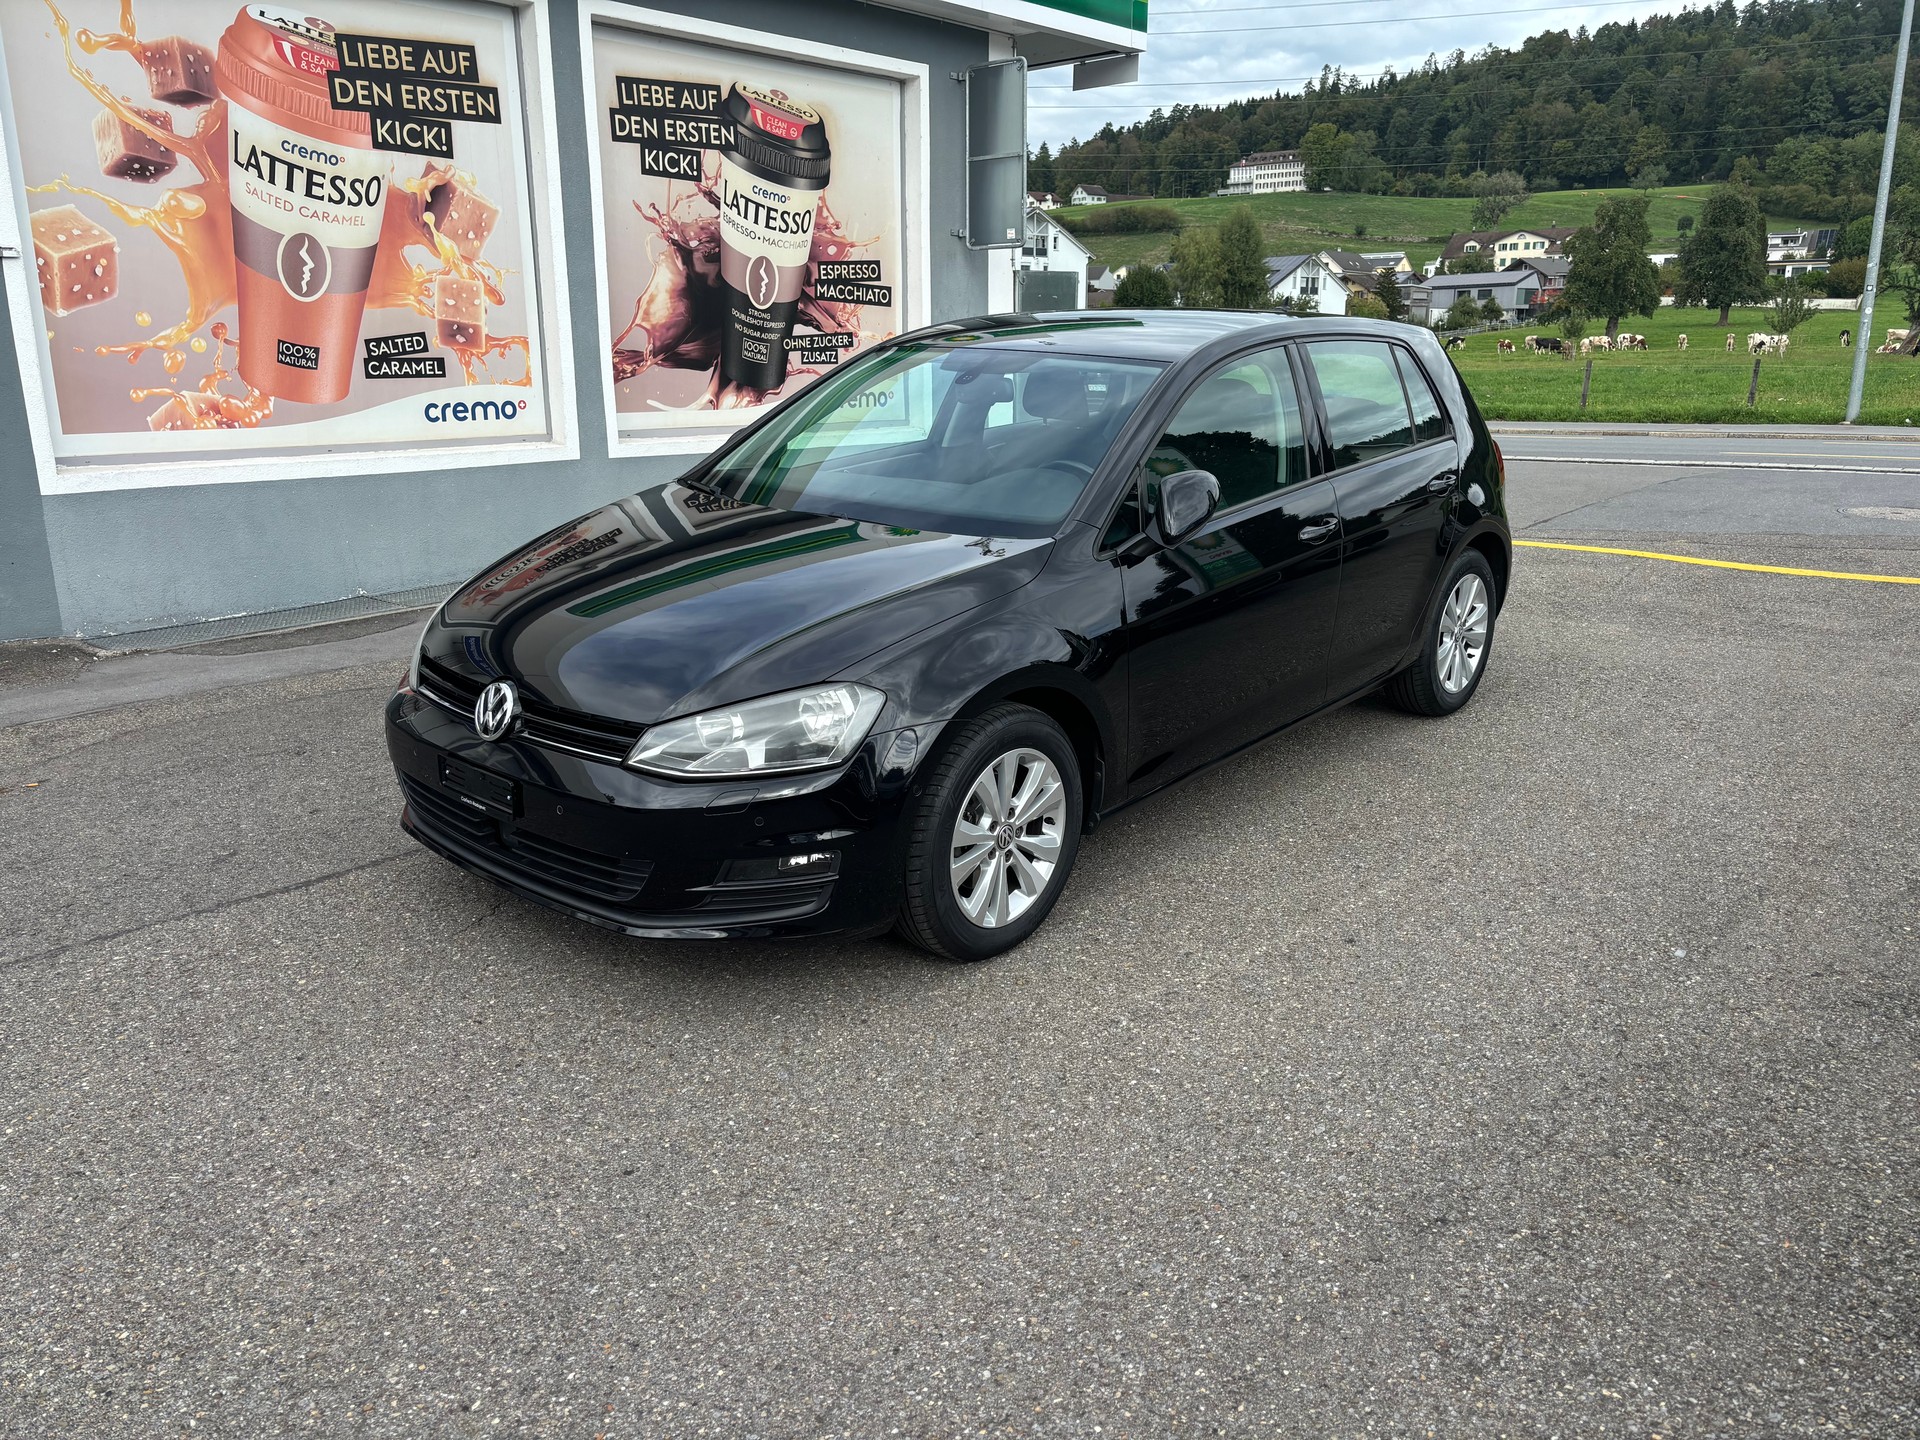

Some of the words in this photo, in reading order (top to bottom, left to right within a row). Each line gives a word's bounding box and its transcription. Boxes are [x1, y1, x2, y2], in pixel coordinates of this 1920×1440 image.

[259, 9, 336, 44] LATTE
[301, 51, 334, 68] CLEAN
[301, 60, 308, 70] &
[310, 63, 327, 75] SAF
[342, 41, 416, 72] LIEBE
[421, 49, 471, 76] AUF
[333, 77, 394, 107] DEN
[400, 83, 496, 117] ERSTEN
[621, 82, 676, 108] LIEBE
[680, 88, 717, 111] AUF
[742, 85, 813, 118] LATTESSO
[614, 114, 658, 139] DEN
[664, 119, 735, 145] ERSTEN
[766, 116, 787, 129] CLEAN
[772, 125, 787, 137] SAFE
[375, 118, 448, 151] KICK!
[281, 139, 339, 166] cremo
[644, 148, 698, 176] KICK!
[233, 129, 382, 207] LATTESSO
[245, 181, 294, 213] SALTED
[298, 206, 366, 226] CARAMEL
[752, 185, 787, 203] cremo
[723, 179, 812, 235] LATTESSO
[723, 211, 757, 240] ESPRESSO
[762, 235, 809, 250] MACCHIATO
[820, 264, 878, 279] ESPRESSO
[816, 283, 889, 303] MACCHIATO
[731, 308, 764, 327] DOUBLESHOT
[763, 321, 786, 329] ESPRESSO
[748, 308, 771, 320] STRONG
[734, 322, 743, 332] NO
[743, 326, 760, 338] SUGAR
[279, 342, 317, 359] 100%
[369, 336, 424, 356] SALTED
[744, 341, 767, 354] 100%
[783, 337, 811, 350] OHNE
[813, 335, 852, 348] ZUCKER-
[278, 354, 317, 369] NATURAL
[743, 350, 767, 361] NATURAL
[802, 351, 837, 362] ZUSATZ
[368, 361, 443, 376] CARAMEL
[841, 391, 888, 408] emo
[424, 400, 517, 423] cremo
